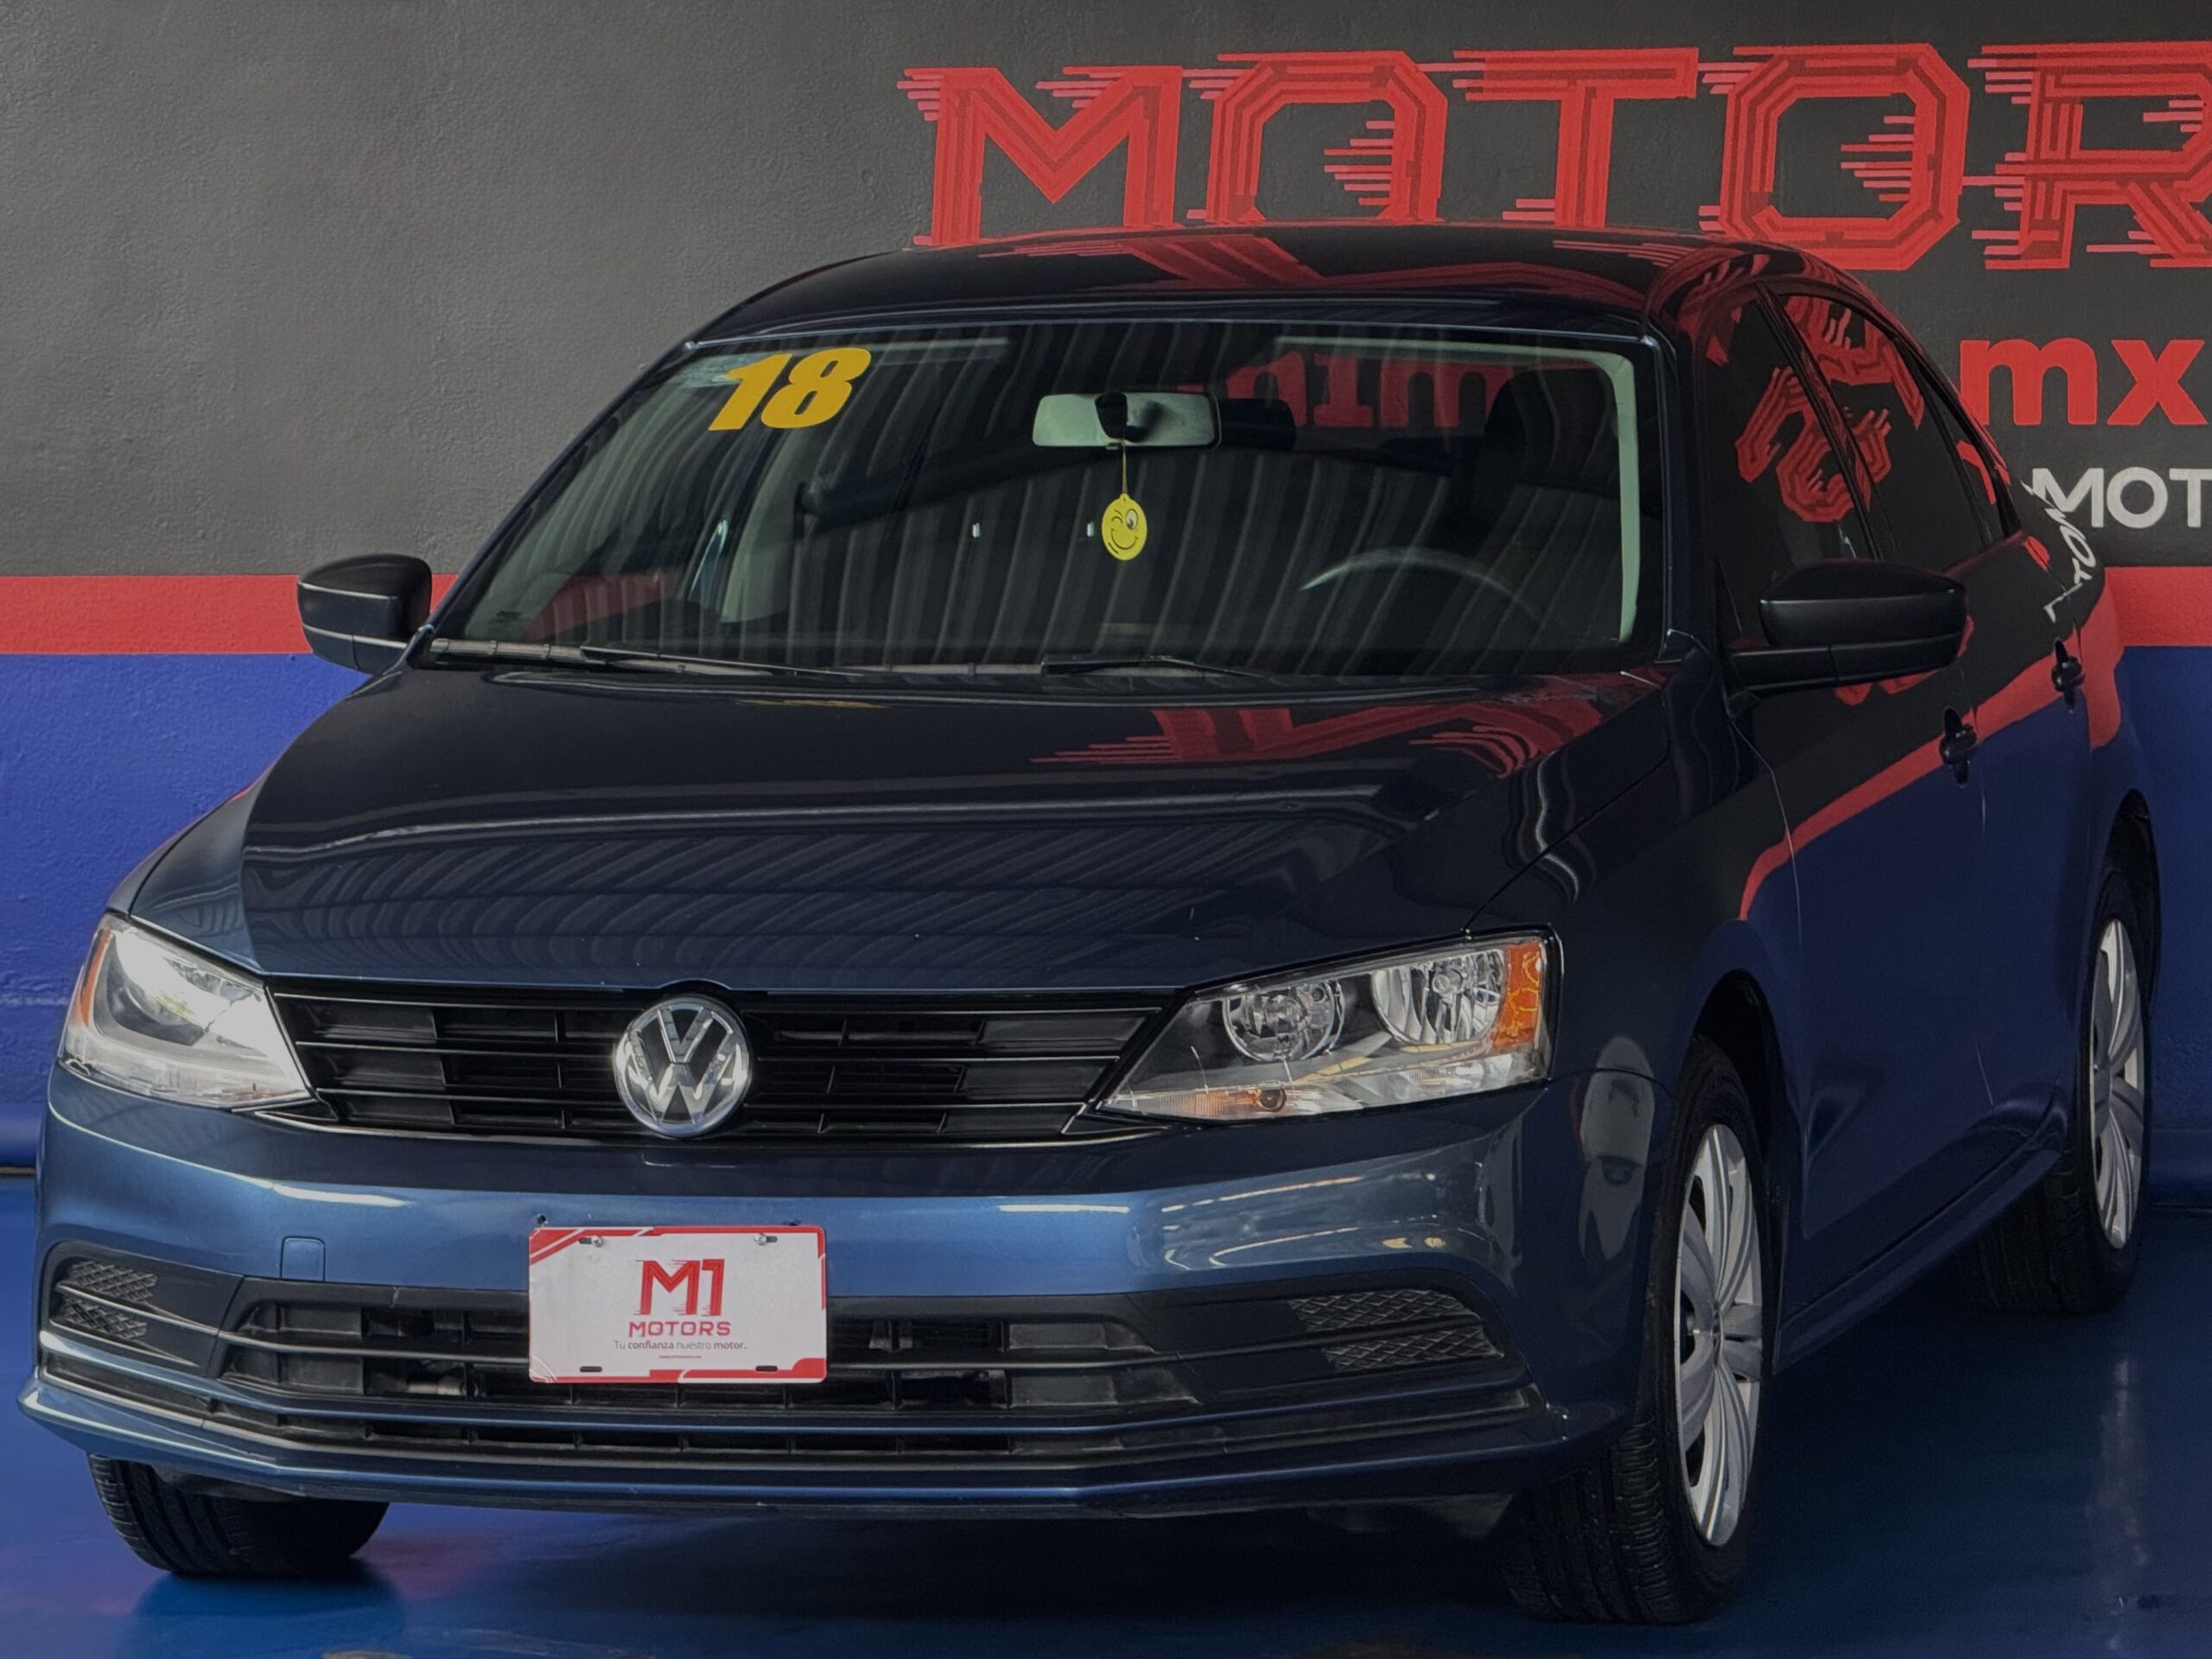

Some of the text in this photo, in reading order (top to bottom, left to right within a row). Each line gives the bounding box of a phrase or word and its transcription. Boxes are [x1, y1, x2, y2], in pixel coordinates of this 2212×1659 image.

[708, 347, 872, 431] 18
[2032, 466, 2212, 529] MOT
[633, 1258, 725, 1317] M1
[613, 1340, 747, 1350] Tu confianza nuestro motor.
[628, 1320, 732, 1338] MOTORS
